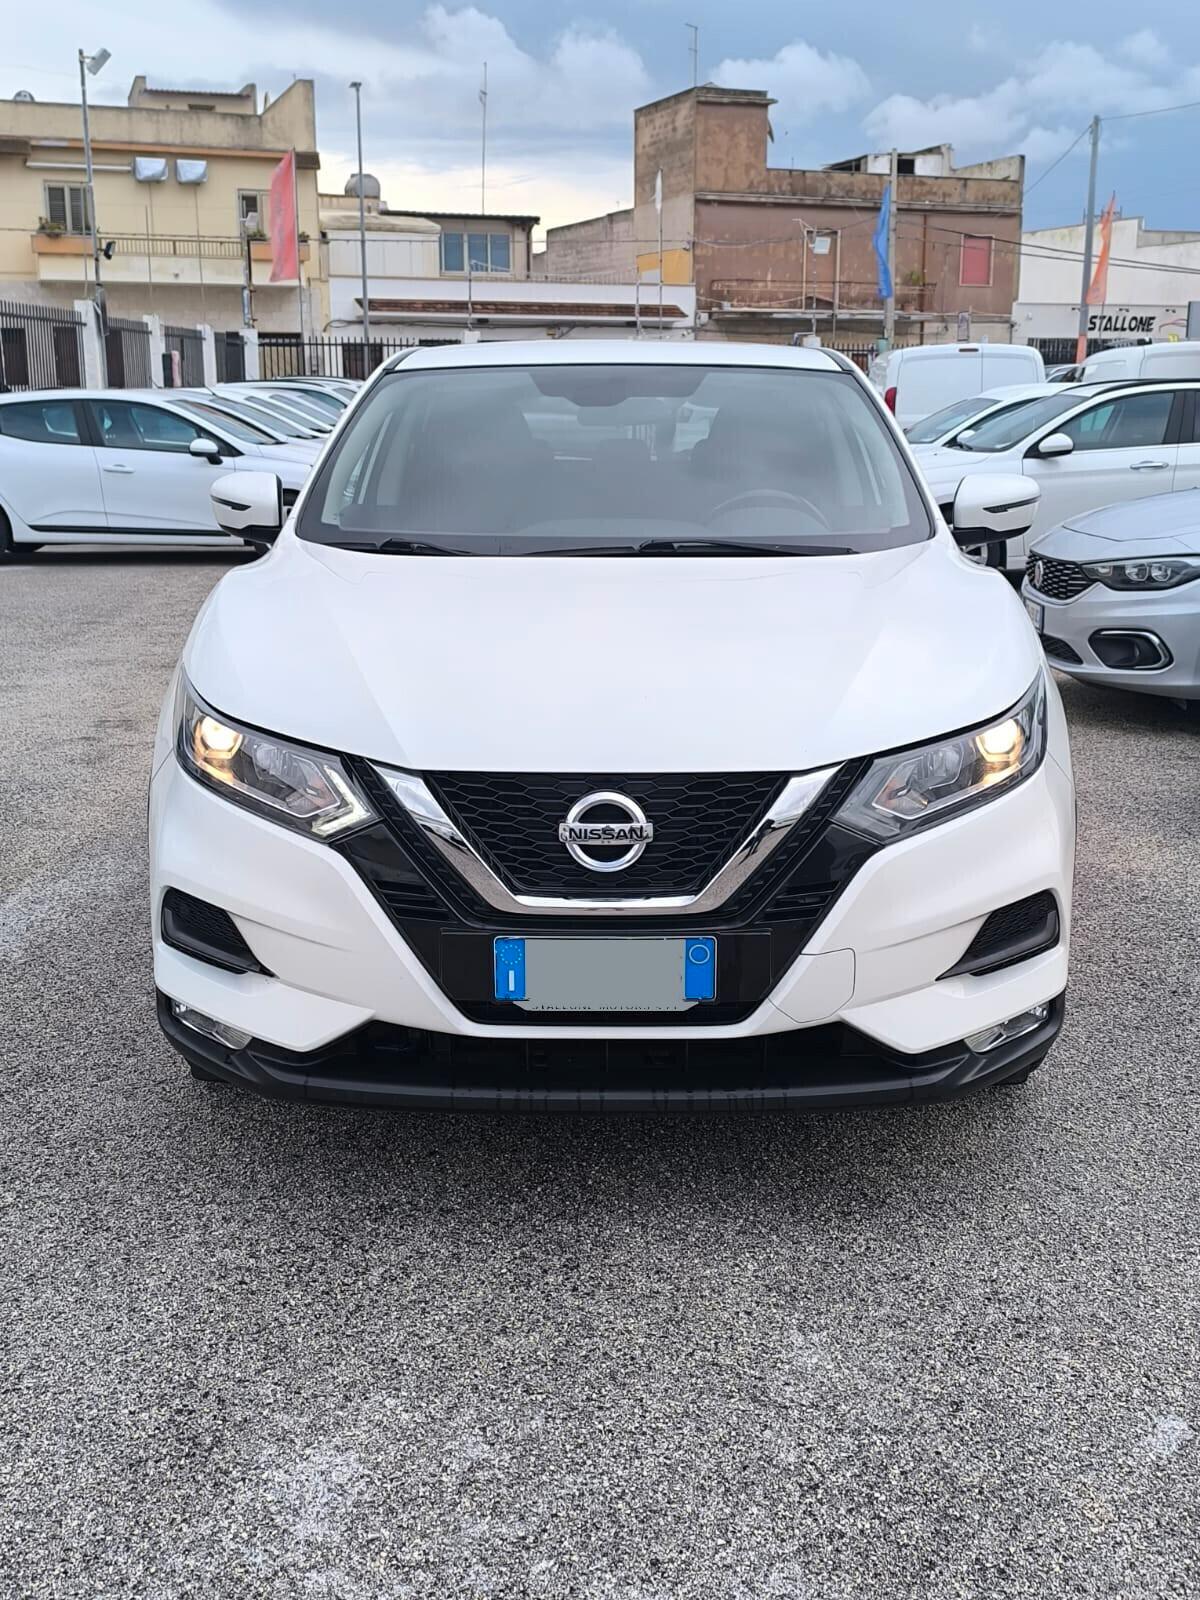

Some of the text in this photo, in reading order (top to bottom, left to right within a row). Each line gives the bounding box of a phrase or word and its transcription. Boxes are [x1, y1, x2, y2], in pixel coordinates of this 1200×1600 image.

[1088, 315, 1156, 332] STALLONE
[568, 826, 643, 841] NISSAN
[508, 970, 515, 991] I
